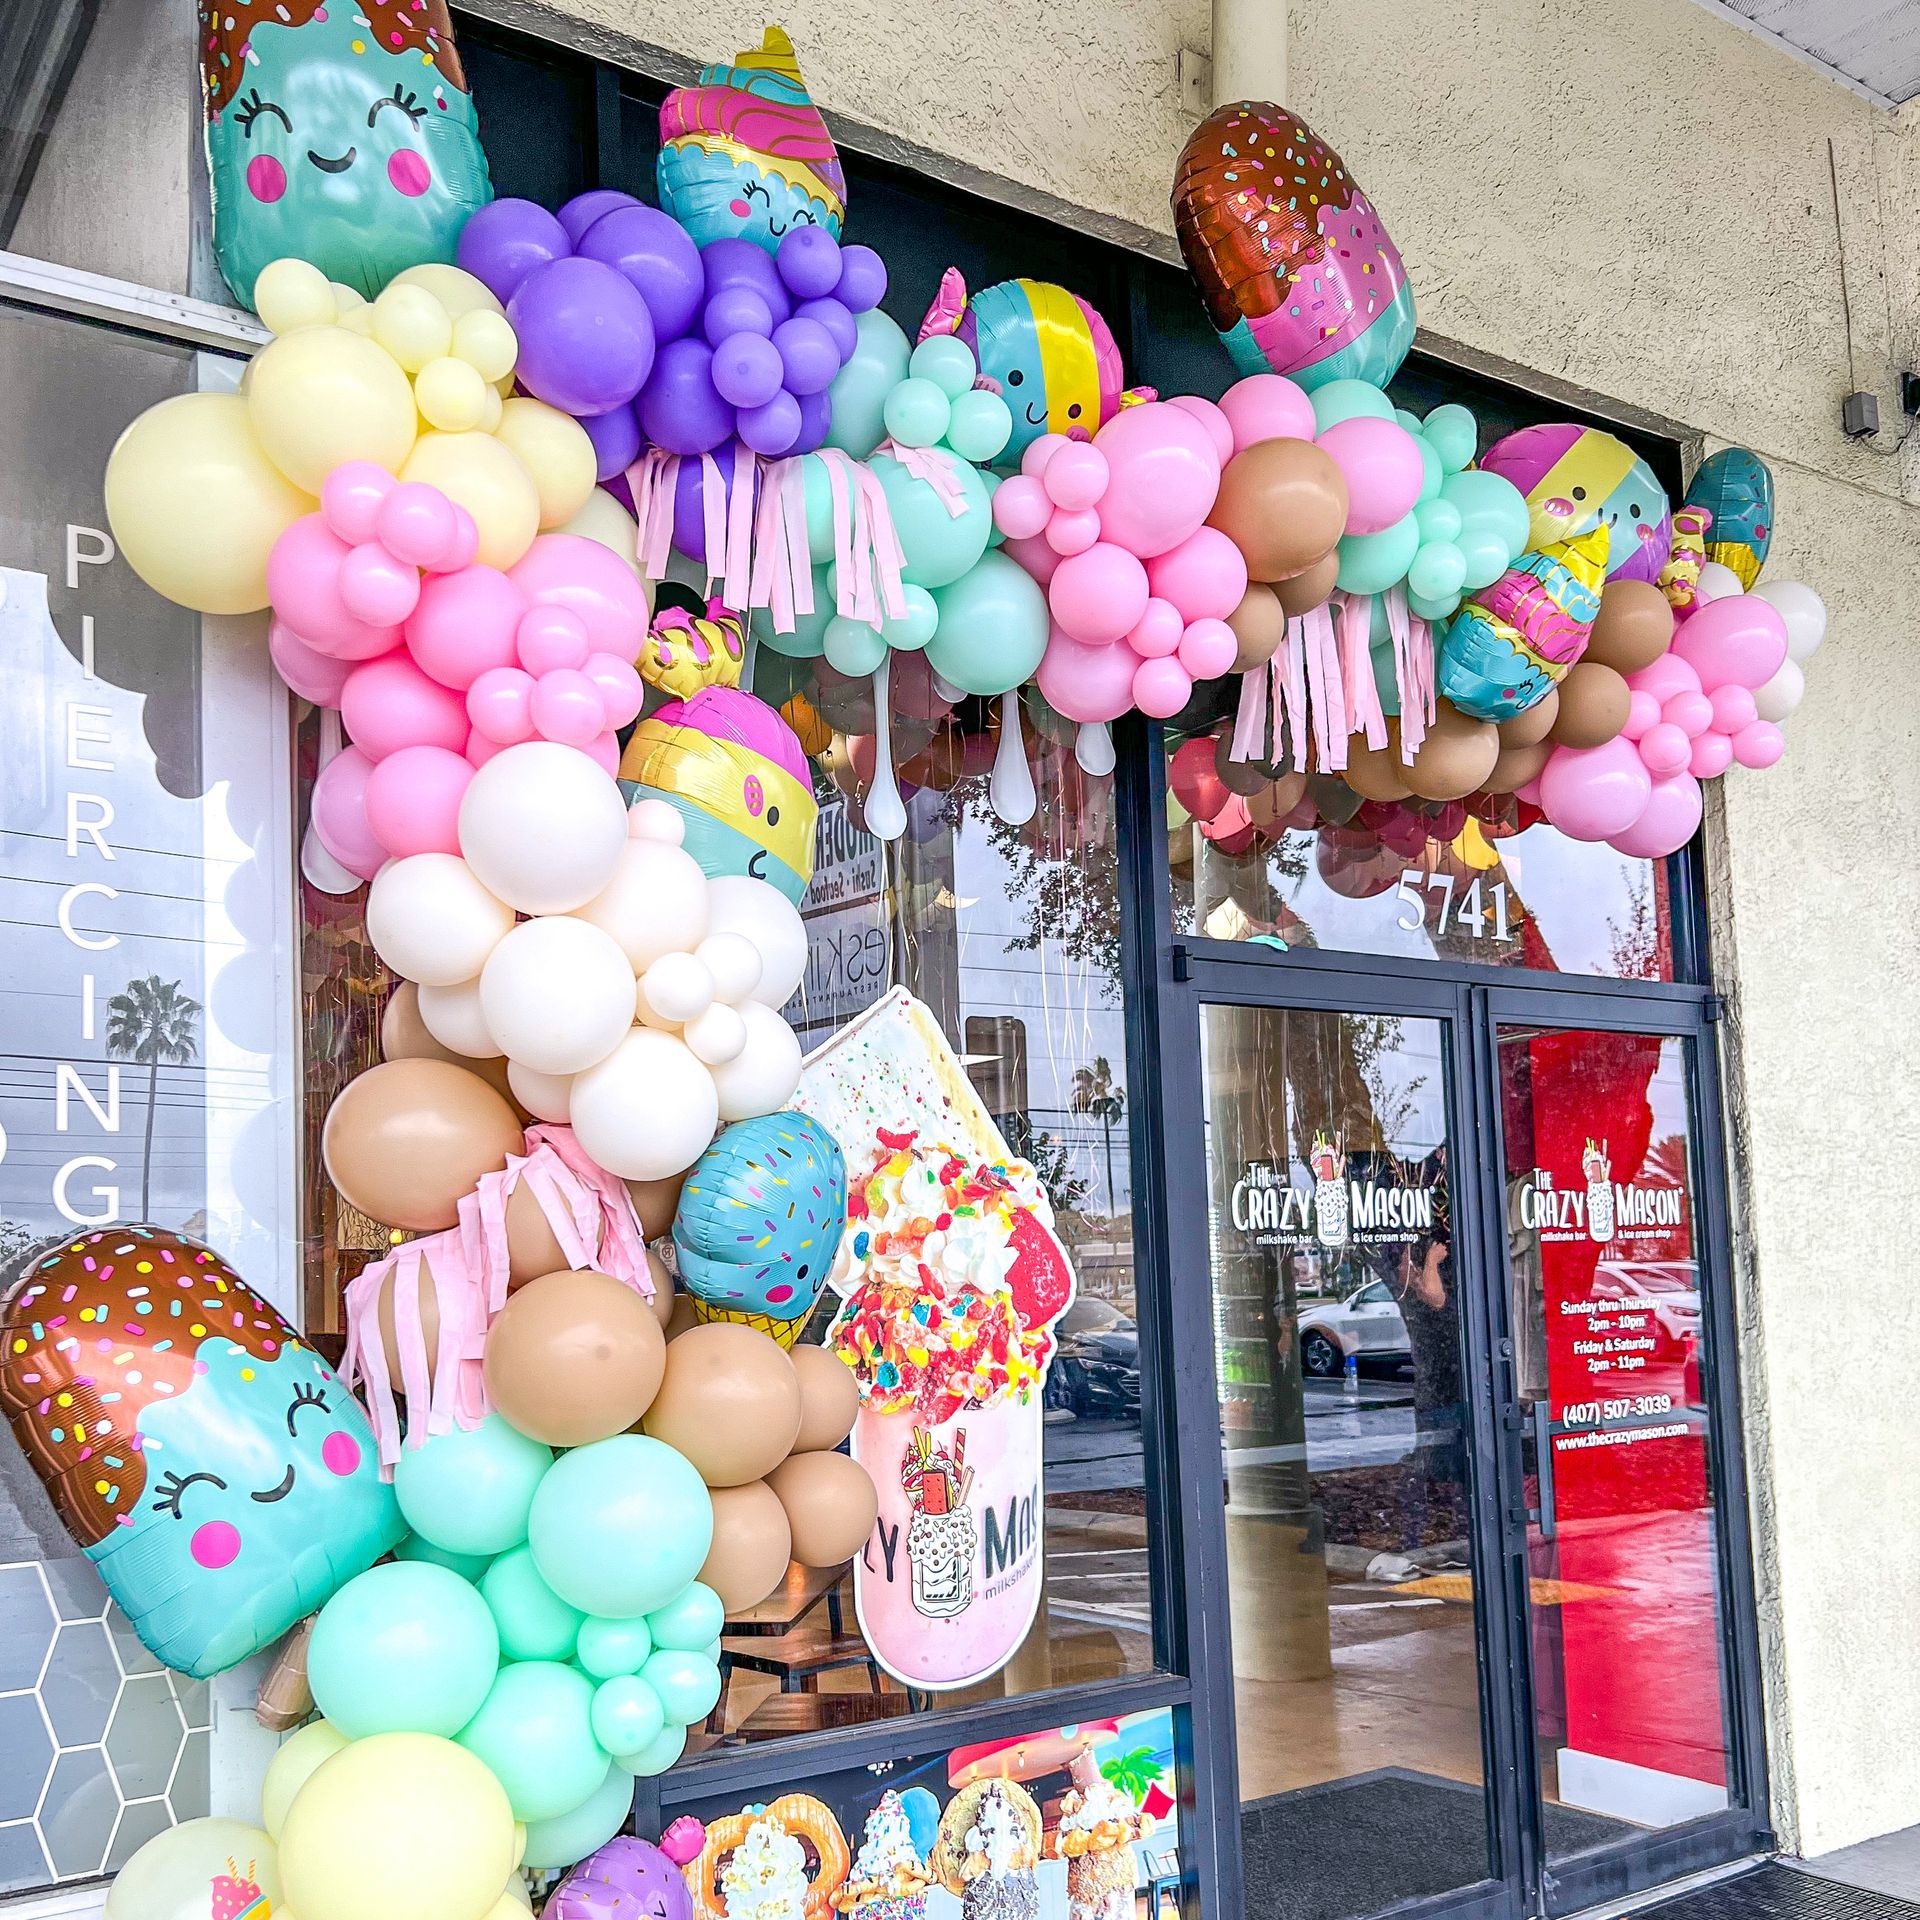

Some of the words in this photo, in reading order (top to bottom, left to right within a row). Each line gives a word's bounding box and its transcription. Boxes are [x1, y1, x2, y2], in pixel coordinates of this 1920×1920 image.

[53, 524, 119, 1225] PIERCING
[1396, 870, 1513, 942] 5741
[1248, 1162, 1271, 1188] THE
[1533, 1168, 1553, 1190] THE
[1231, 1180, 1310, 1231] CRAZY
[1521, 1183, 1584, 1229] CRAZY
[1256, 1233, 1297, 1245] milkshake
[1299, 1233, 1313, 1244] bar
[1353, 1234, 1360, 1243] &
[1361, 1233, 1373, 1243] ice
[1375, 1234, 1398, 1243] cream
[1399, 1232, 1419, 1244] shop
[1541, 1232, 1574, 1242] milkshake
[1575, 1231, 1586, 1241] bar
[1624, 1230, 1634, 1239] ice
[1635, 1230, 1654, 1239] cream
[1655, 1229, 1671, 1240] shop
[1561, 1300, 1597, 1315] Sunday
[1598, 1299, 1618, 1312] thru
[1619, 1297, 1661, 1311] Thursday
[1587, 1317, 1609, 1333] 2pm
[1618, 1315, 1645, 1330] 10pm
[1573, 1340, 1603, 1355] Friday
[1605, 1338, 1613, 1352] &
[1614, 1336, 1656, 1351] Saturday
[1587, 1358, 1610, 1373] 2pm
[1617, 1355, 1645, 1370] 11pm
[1563, 1402, 1600, 1429] (407)
[1604, 1394, 1671, 1420] 507-3039
[1556, 1423, 1688, 1451] www.thecrazymason.com
